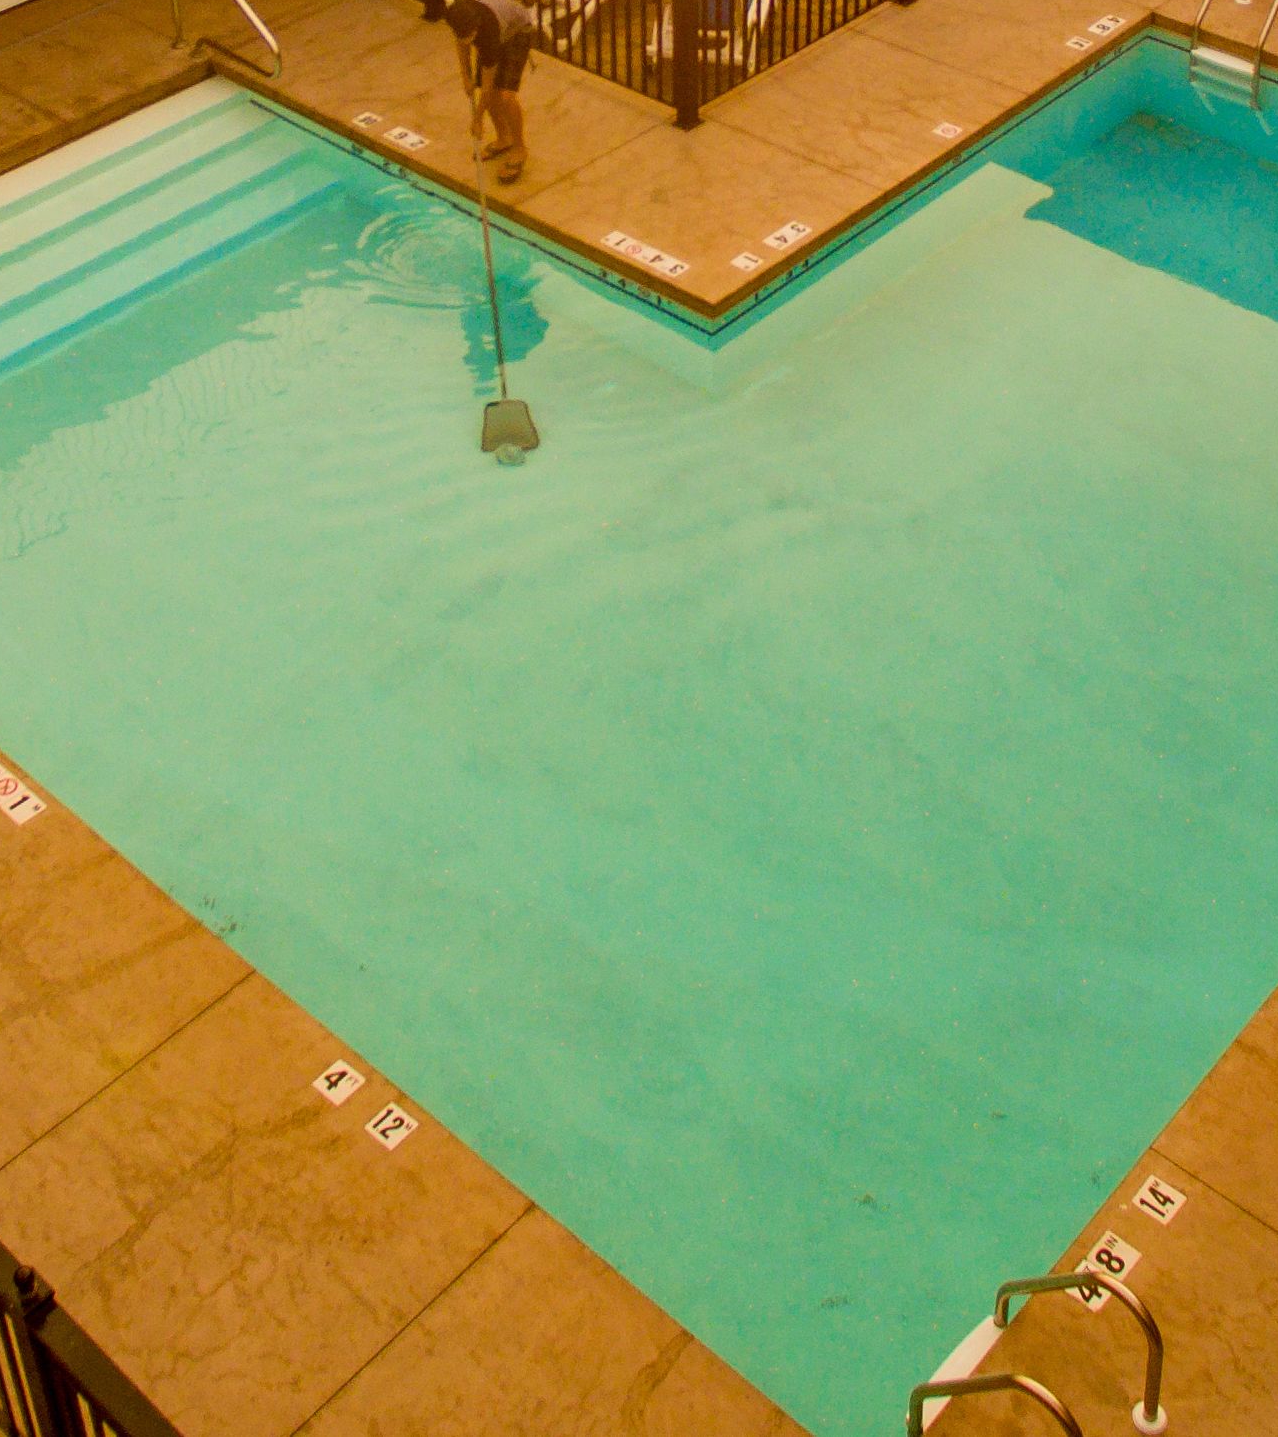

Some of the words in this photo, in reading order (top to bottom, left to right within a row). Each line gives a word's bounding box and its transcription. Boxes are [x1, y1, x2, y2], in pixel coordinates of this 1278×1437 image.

[9, 795, 31, 811] 1
[324, 1070, 348, 1091] 4
[1095, 1247, 1126, 1274] 8
